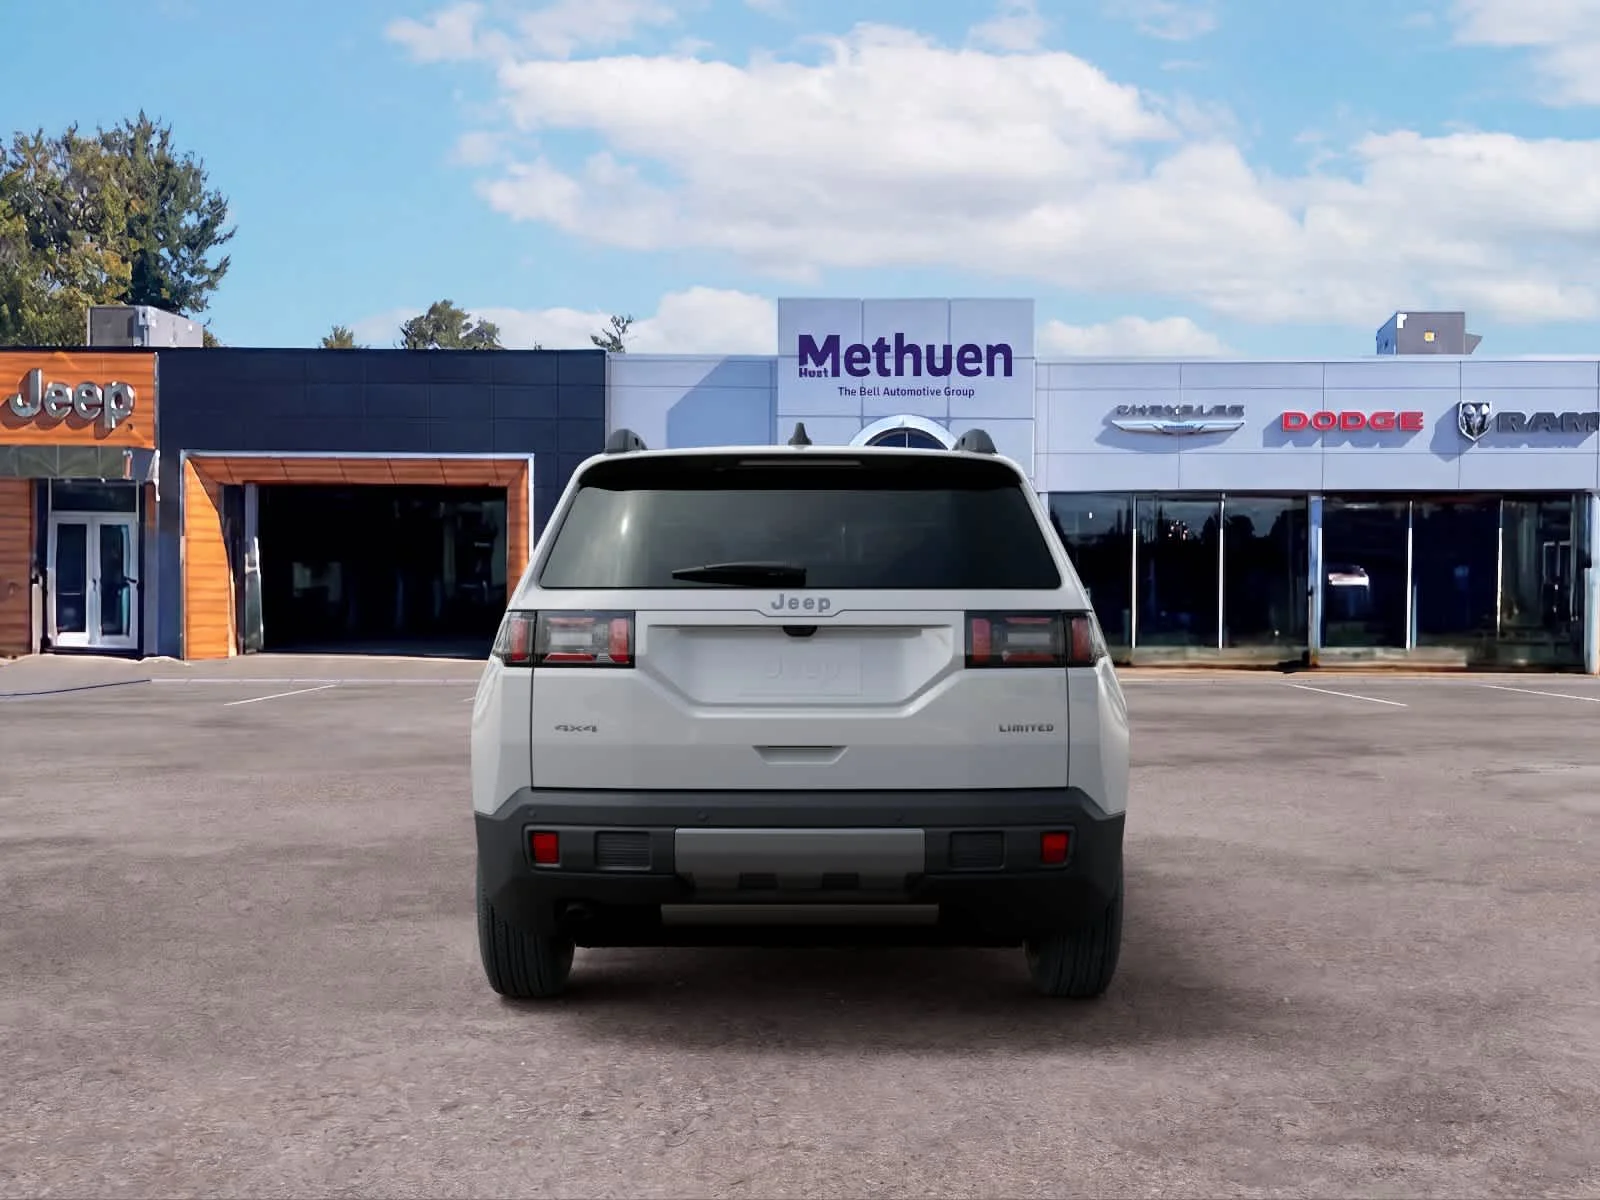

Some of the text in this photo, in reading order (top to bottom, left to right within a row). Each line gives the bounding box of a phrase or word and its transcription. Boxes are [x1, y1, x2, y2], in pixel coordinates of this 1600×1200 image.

[798, 332, 1013, 378] Methuen
[9, 367, 136, 430] Jeep
[838, 386, 975, 399] The Bell Automotive Group
[1281, 410, 1424, 432] DODGE
[1497, 411, 1600, 433] RAM
[770, 593, 832, 613] Jeep
